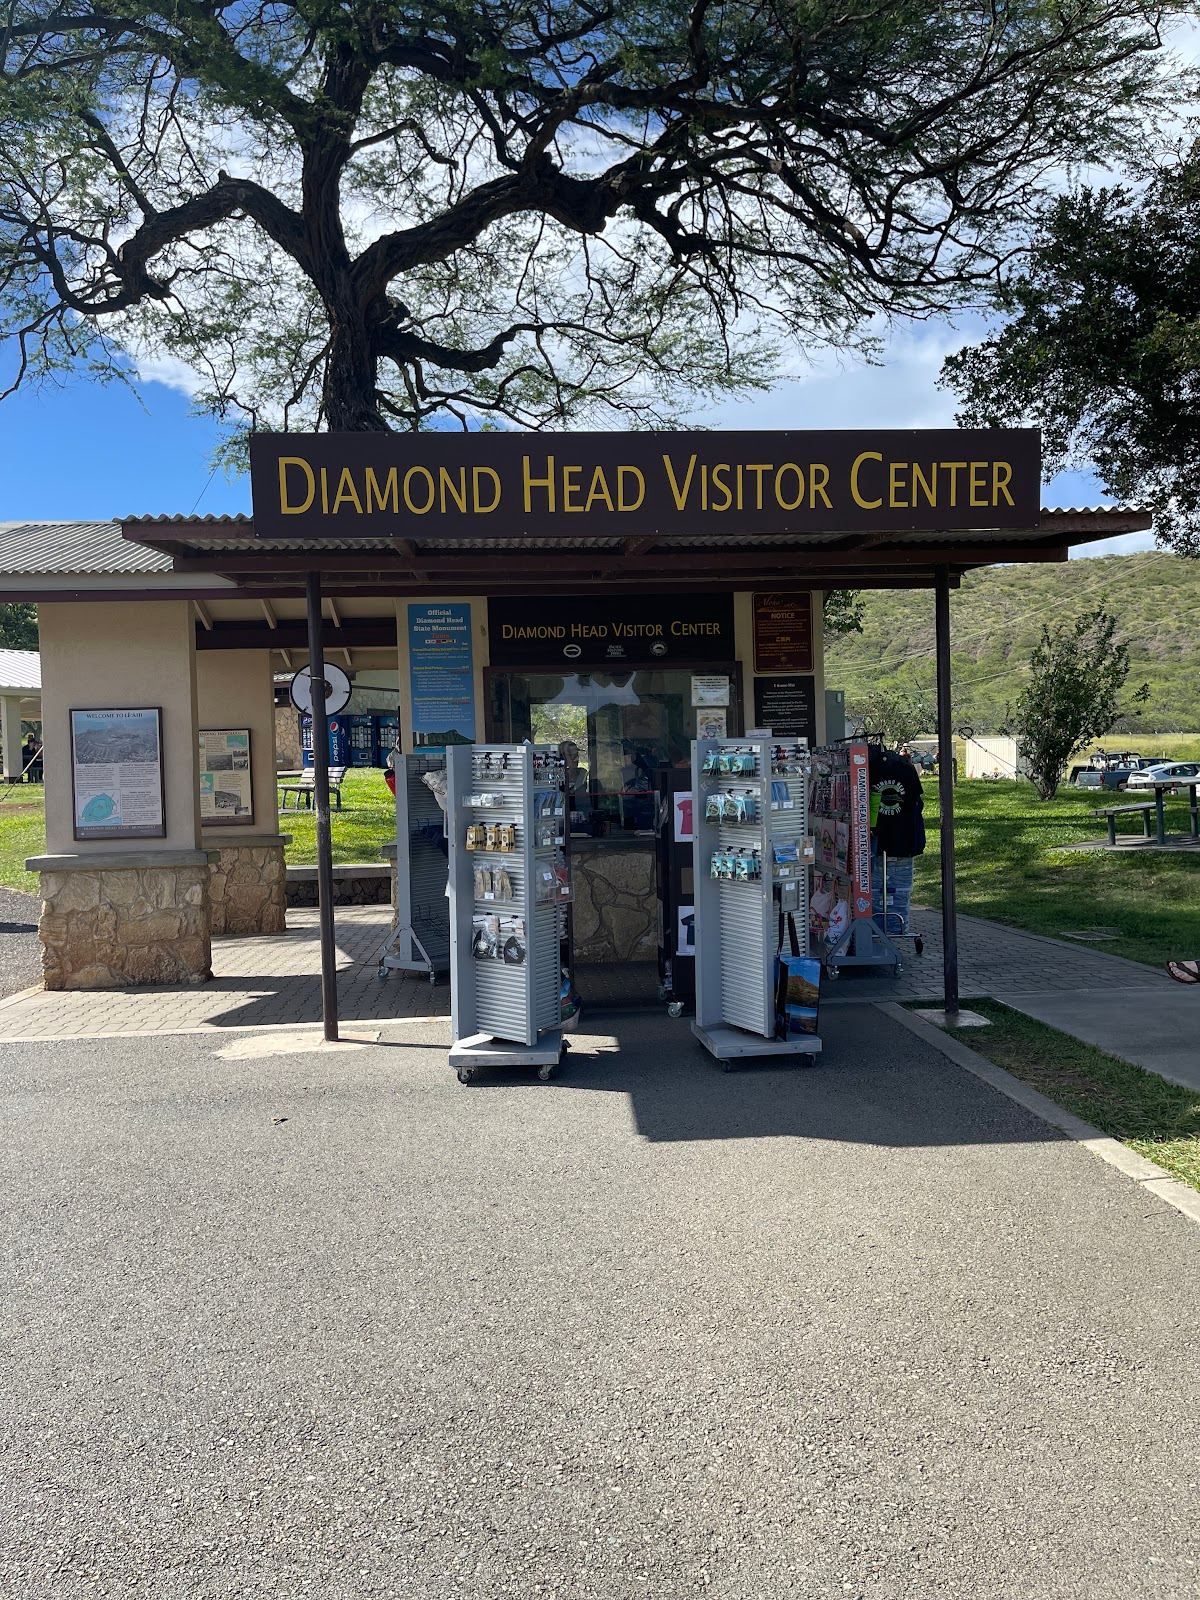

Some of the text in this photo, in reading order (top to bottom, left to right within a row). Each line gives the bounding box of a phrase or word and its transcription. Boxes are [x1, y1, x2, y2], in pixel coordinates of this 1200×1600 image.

[278, 451, 1016, 515] DIAMOND HEAD VISITOR CENTER
[502, 621, 721, 639] DIAMOND HEAD VISITOR CENTER
[332, 736, 340, 762] pepsi
[858, 768, 870, 894] DIAMOND HEAD STATE MONUMENT
